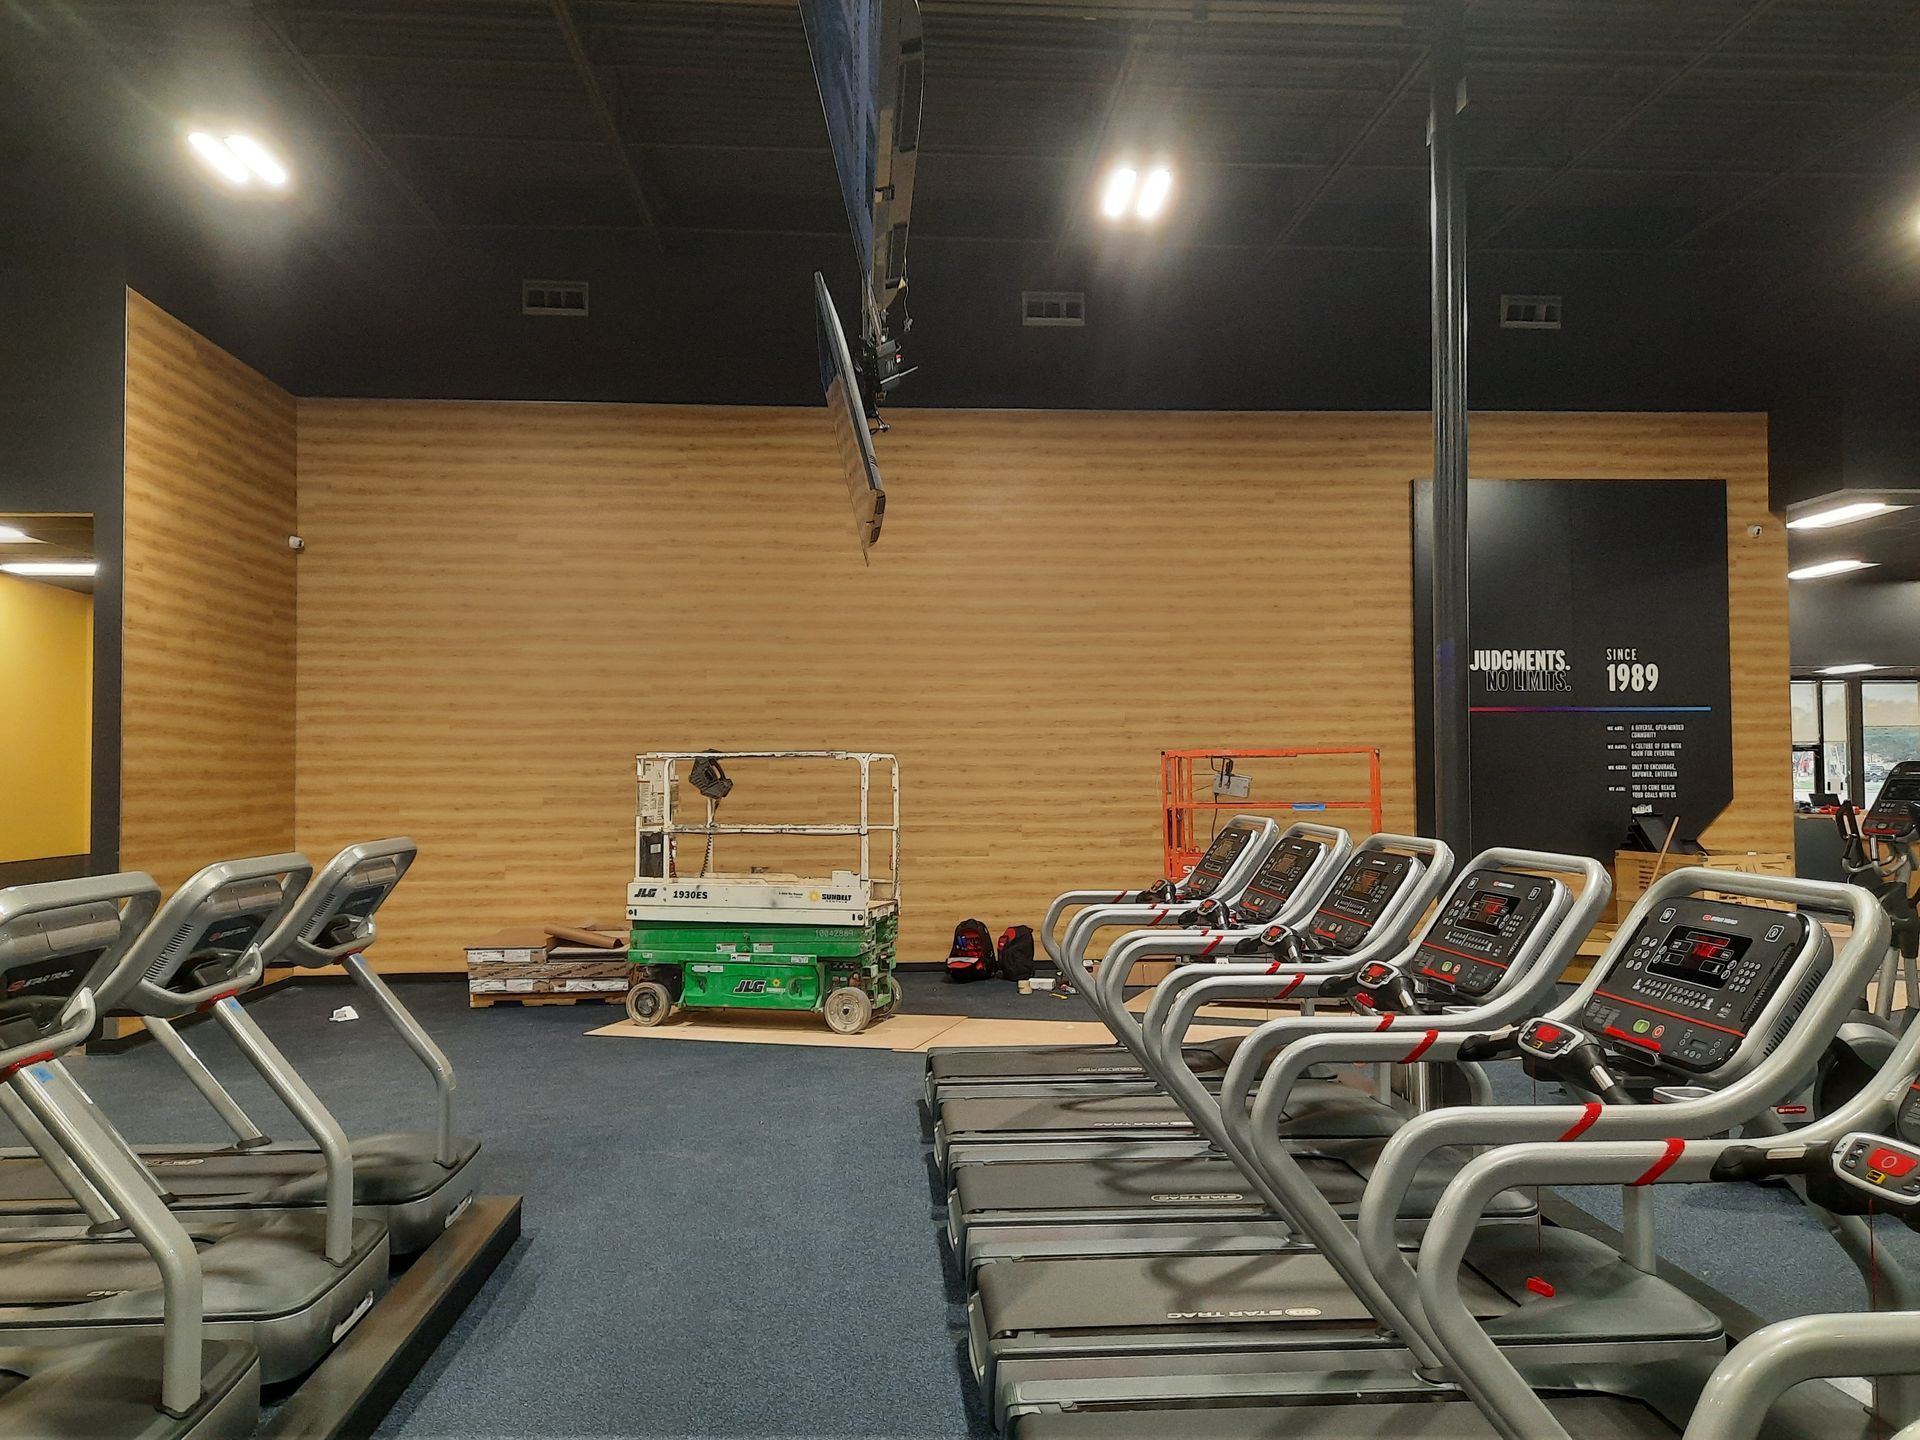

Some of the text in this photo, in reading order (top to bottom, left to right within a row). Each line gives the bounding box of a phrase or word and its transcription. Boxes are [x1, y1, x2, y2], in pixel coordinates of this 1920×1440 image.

[1606, 648, 1637, 661] SINCE
[1469, 649, 1571, 671] JUDGMENTS.
[1485, 670, 1572, 692] NO LIMITS.
[1606, 663, 1659, 692] 1989
[1635, 742, 1654, 750] CULTURE
[1631, 763, 1643, 771] ONLY
[1643, 763, 1649, 771] TO
[1632, 791, 1677, 799] YOUR GOALS WITH US
[634, 888, 658, 898] JLG
[673, 890, 708, 900] 1930ES
[821, 893, 852, 901] SUNBELT
[733, 979, 767, 994] JLG
[1166, 1309, 1283, 1320] STAR TRAC
